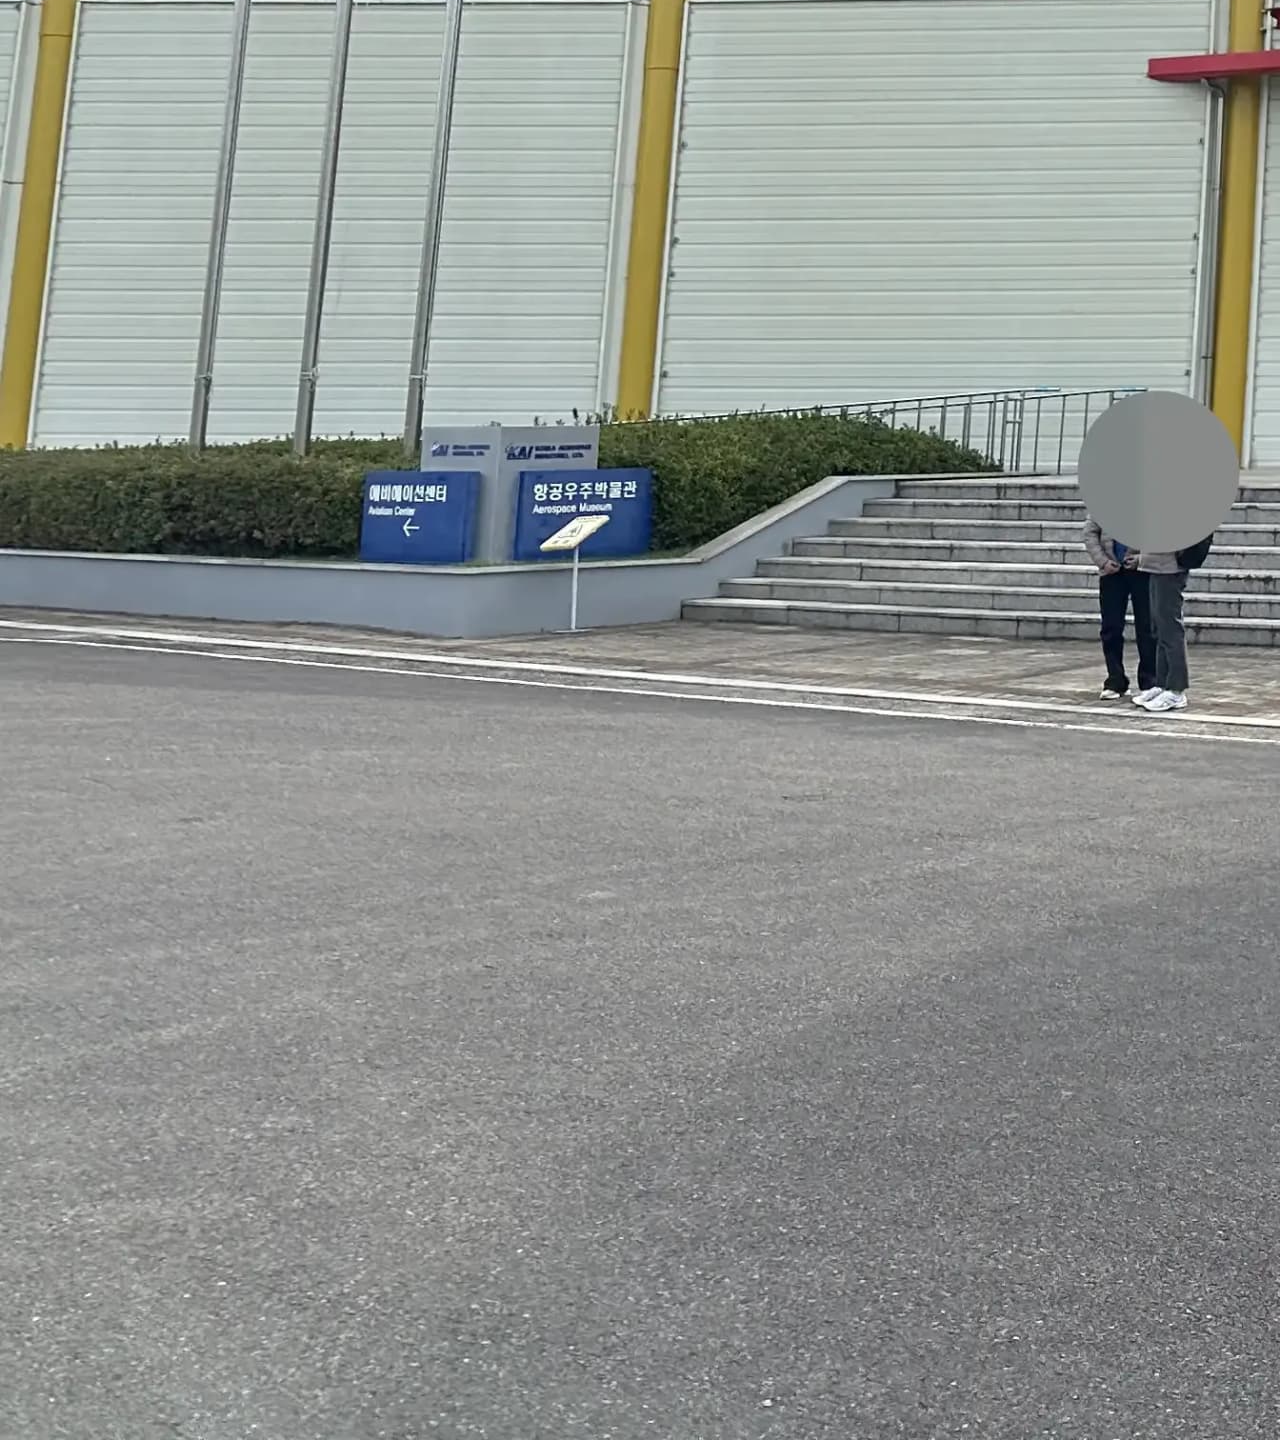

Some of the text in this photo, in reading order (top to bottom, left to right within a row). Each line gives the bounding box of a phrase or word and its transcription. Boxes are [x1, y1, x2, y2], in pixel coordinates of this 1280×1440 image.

[505, 443, 534, 460] KAI
[533, 481, 638, 501] 항공우주박물관
[532, 503, 613, 515] Aerospace Museum
